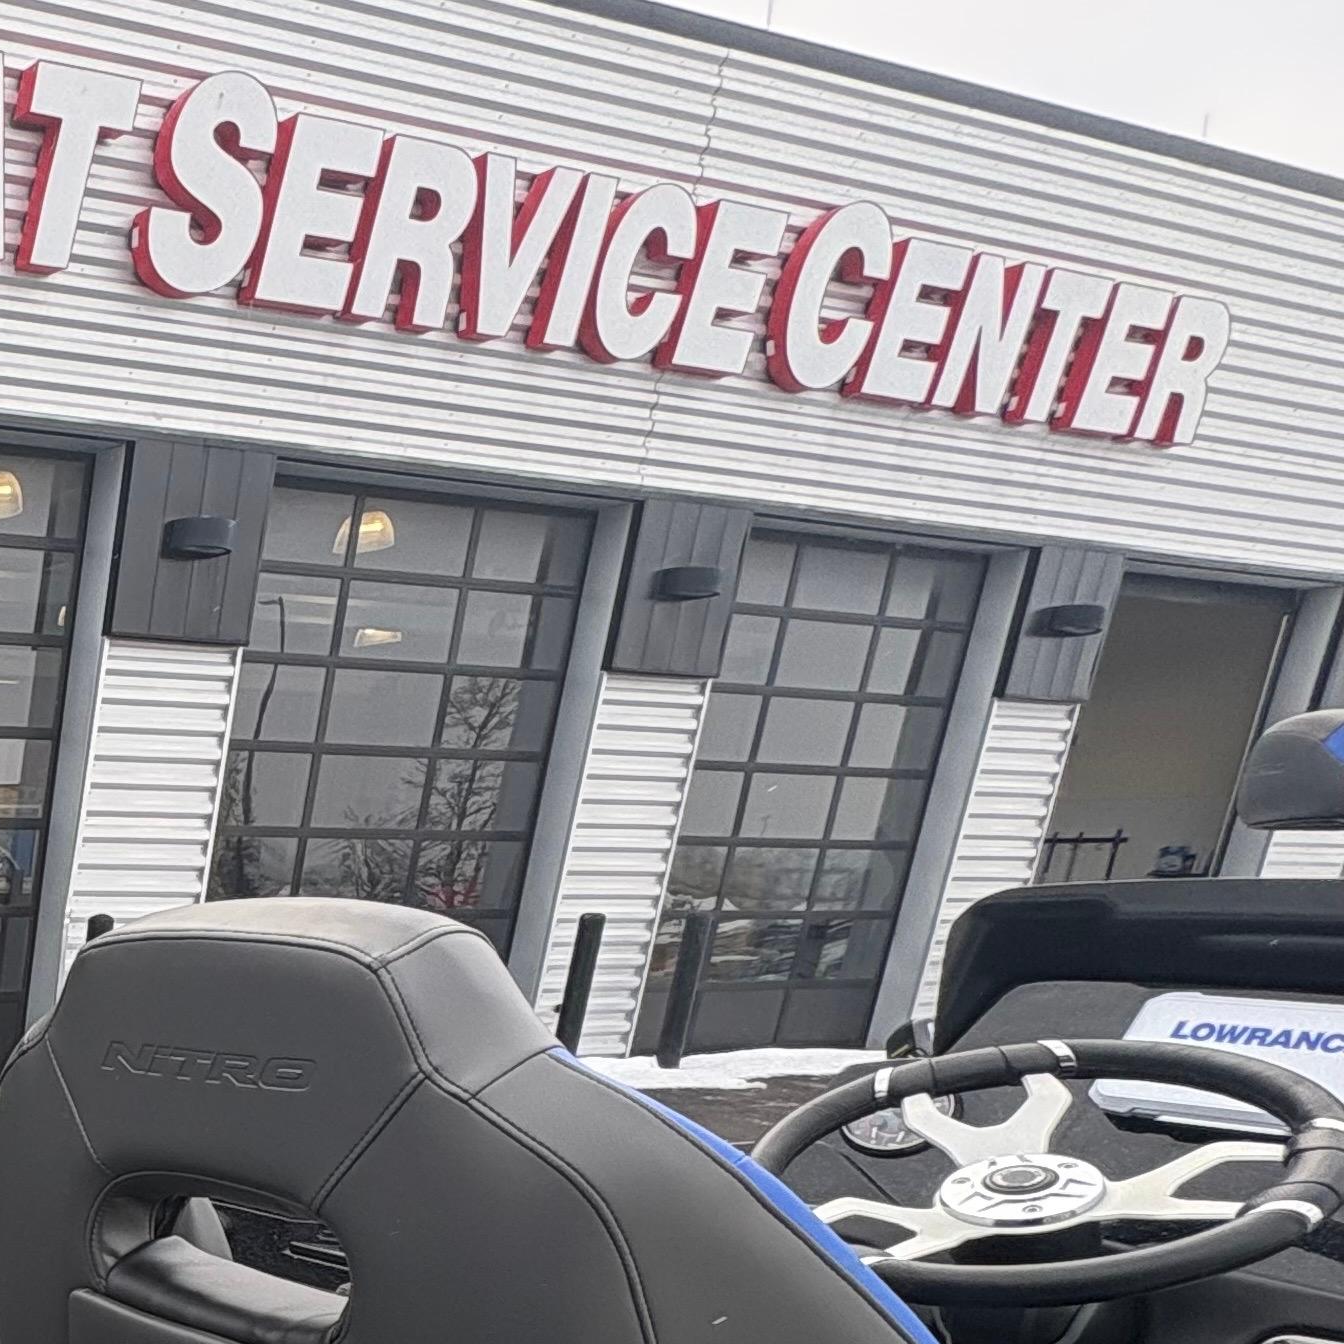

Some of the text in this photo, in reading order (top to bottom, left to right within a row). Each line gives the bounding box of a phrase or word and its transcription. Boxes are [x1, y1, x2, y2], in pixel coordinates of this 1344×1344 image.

[132, 69, 790, 378] SERVICE
[766, 200, 1232, 446] CENTER
[101, 1040, 317, 1092] NITRO
